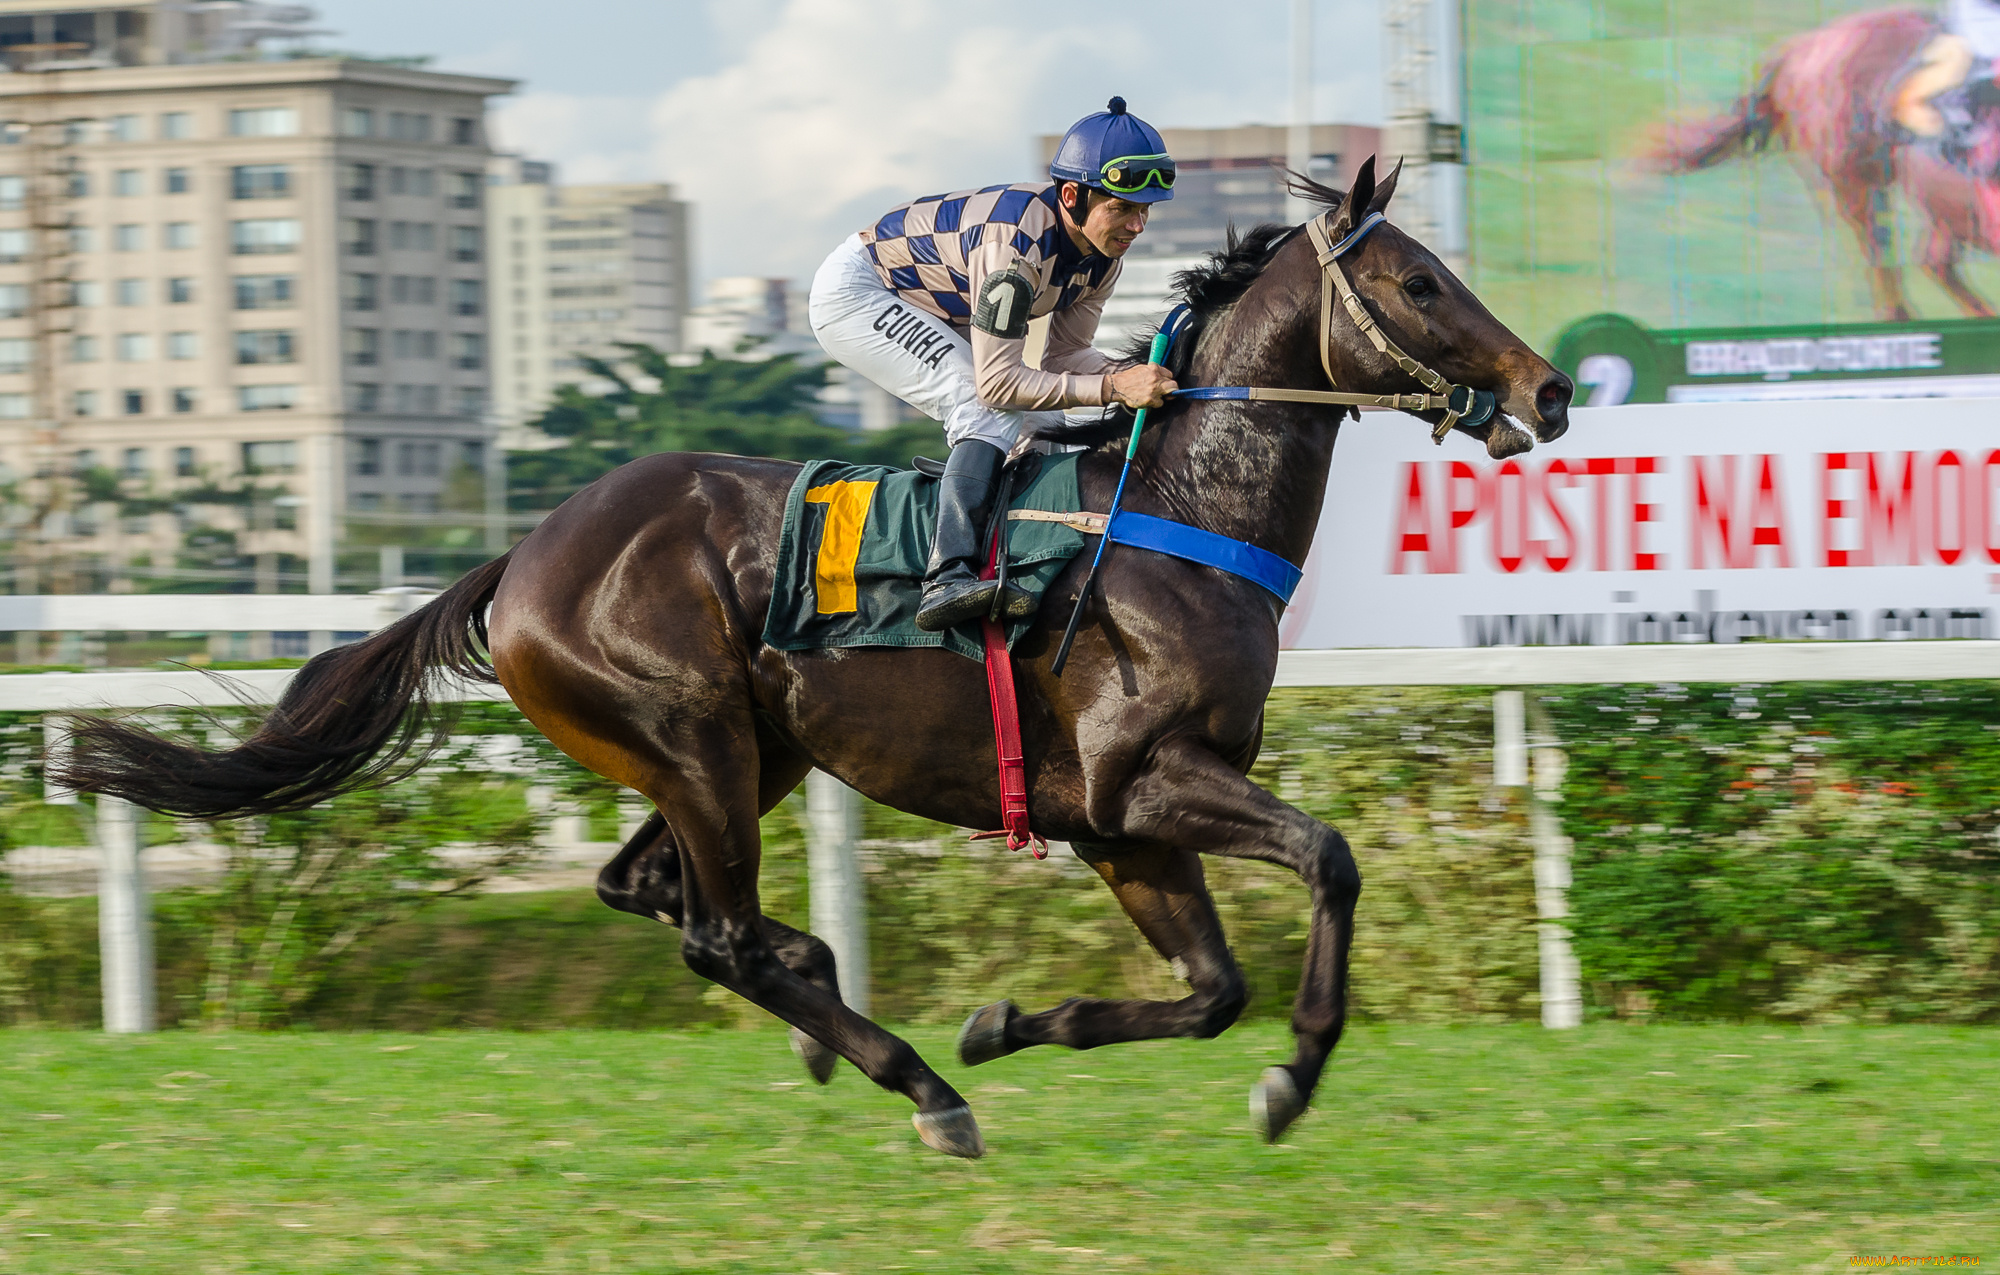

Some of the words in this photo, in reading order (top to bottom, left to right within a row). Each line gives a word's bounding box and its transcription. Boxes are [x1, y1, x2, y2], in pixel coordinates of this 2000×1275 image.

[872, 303, 956, 370] CUNHA
[986, 282, 1016, 331] 1
[804, 480, 880, 614] 1
[1387, 458, 1668, 574] APOSTE
[1685, 454, 1795, 569] NA
